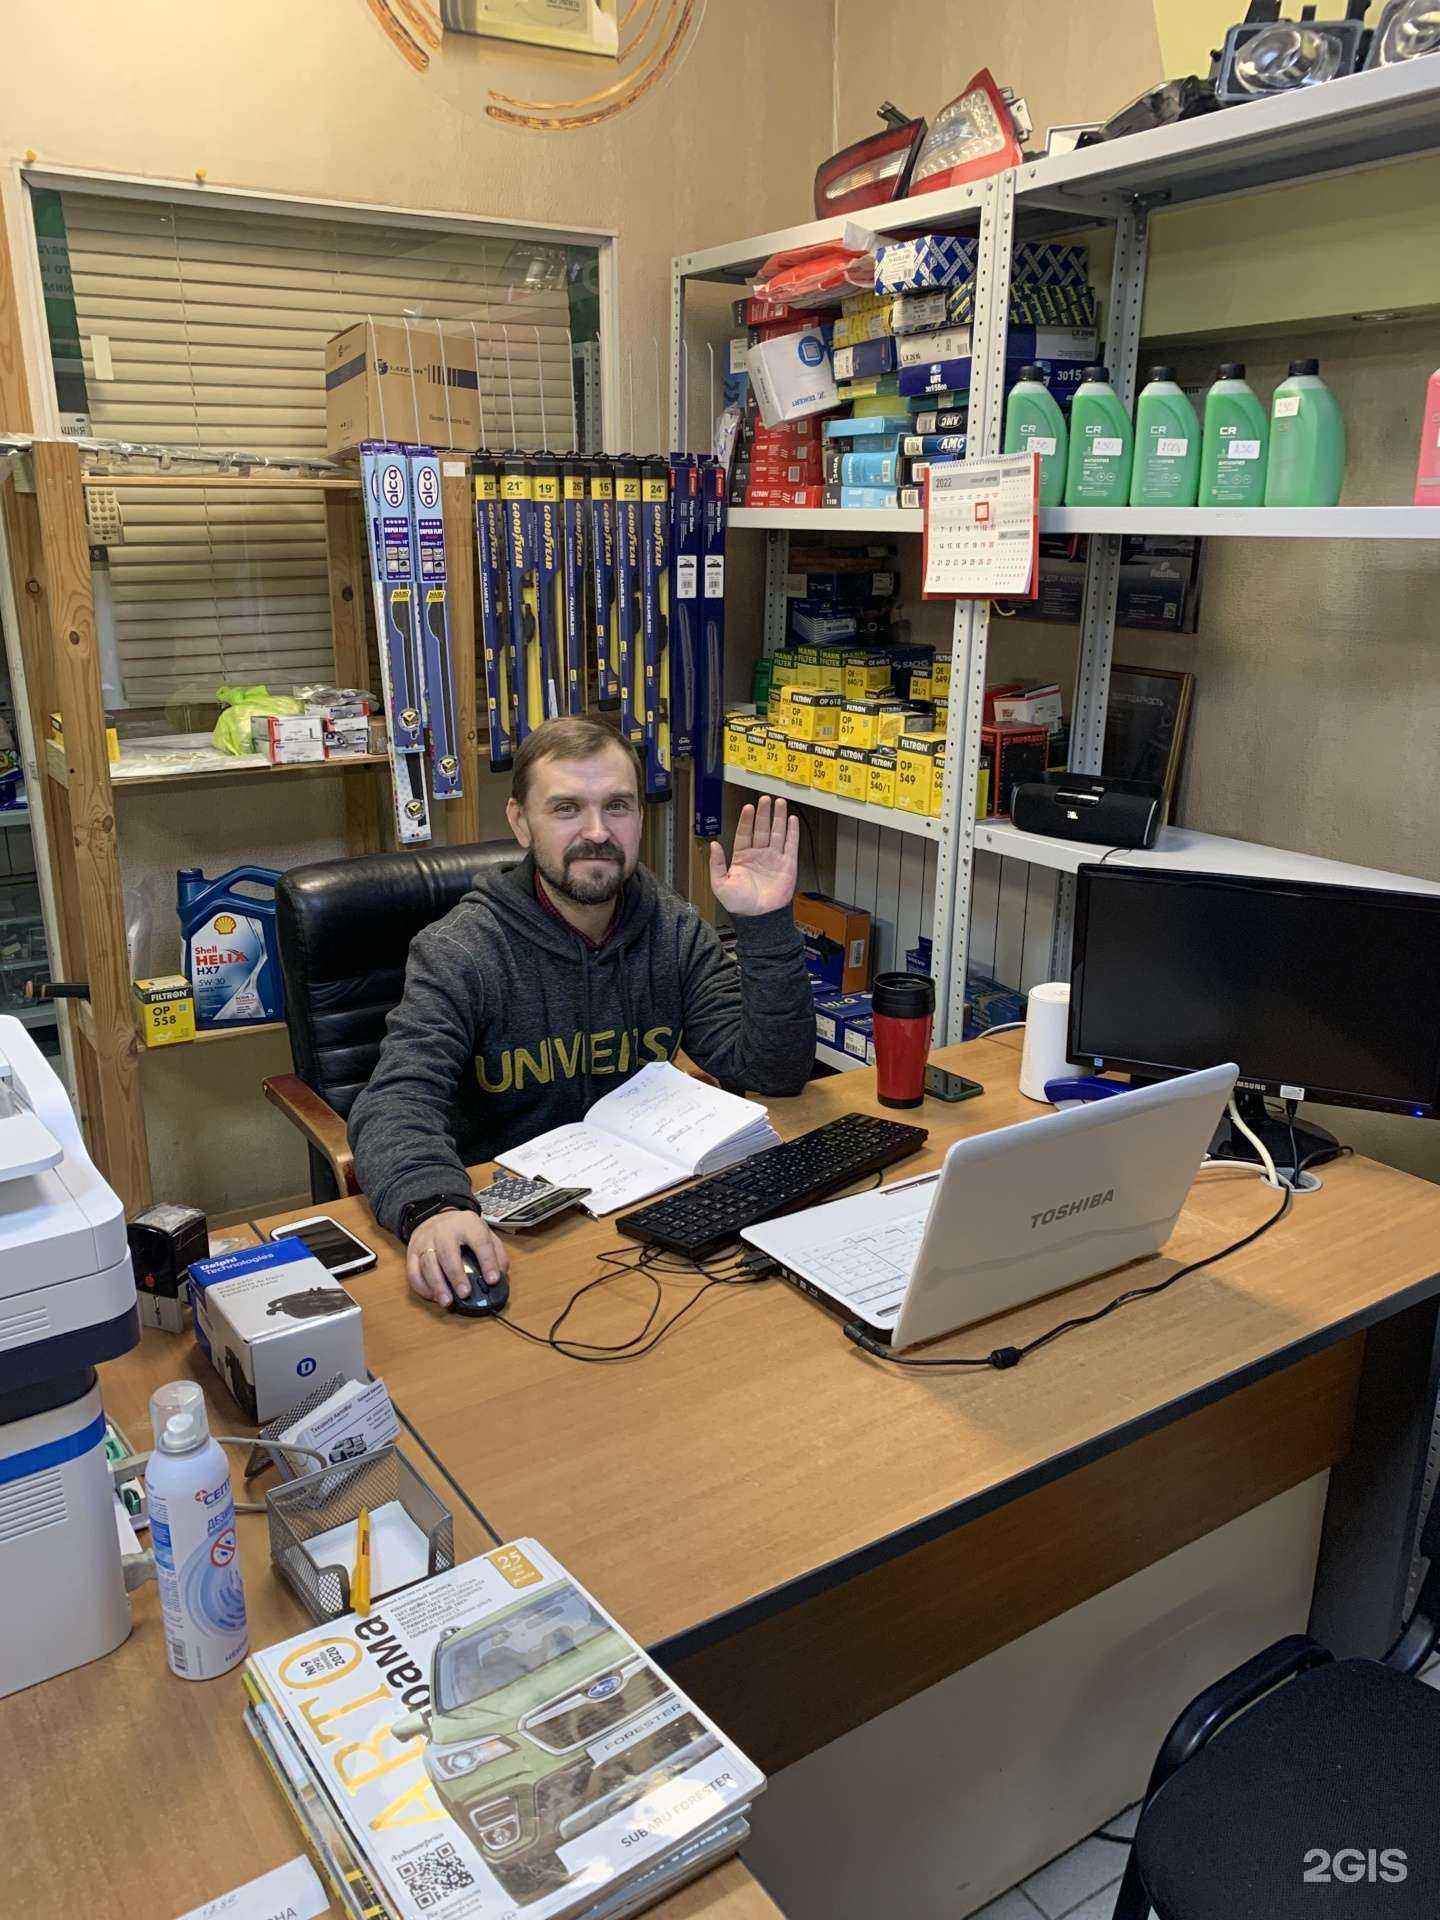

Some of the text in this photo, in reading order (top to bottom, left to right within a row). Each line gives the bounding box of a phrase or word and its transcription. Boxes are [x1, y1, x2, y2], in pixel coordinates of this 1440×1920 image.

[1057, 369, 1082, 381] 3015
[1020, 424, 1037, 433] CR
[1085, 425, 1102, 434] CR
[1150, 426, 1167, 434] CR
[1219, 426, 1237, 435] CR
[941, 437, 964, 450] AMC
[387, 469, 399, 504] alca
[422, 471, 433, 505] alca
[936, 477, 952, 488] 2022
[488, 502, 498, 569] GOODYEAR
[512, 502, 524, 569] GOODYEAR
[543, 504, 555, 569] GOODYEAR
[575, 502, 585, 567] GOODYEAR
[603, 503, 612, 566] GOODYEAR
[628, 504, 638, 567] GOODYEAR
[654, 504, 664, 567] GOODYEAR
[792, 695, 812, 704] FILTRON
[792, 707, 801, 715] OP
[846, 704, 867, 713] FILTRON
[791, 717, 803, 727] 618
[841, 716, 852, 724] OP
[768, 731, 785, 740] FILTRON
[840, 726, 855, 735] 617
[747, 735, 764, 745] FILTRON
[901, 740, 929, 752] FILTRON
[788, 742, 808, 751] FILTRON
[815, 746, 835, 758] FILTRON
[767, 753, 778, 762] 575
[840, 750, 864, 760] FILTRON
[787, 764, 798, 772] 557
[871, 758, 893, 768] FILTRON
[900, 761, 912, 770] OP
[900, 773, 916, 784] 549
[870, 780, 890, 793] 540/1
[194, 945, 217, 955] Shell
[195, 952, 248, 966] HELIX
[197, 966, 220, 976] HX7
[151, 989, 189, 1002] FILTRON
[152, 1007, 170, 1016] OP
[153, 1015, 177, 1027] 558
[1031, 1188, 1115, 1229] TOSHIBA
[199, 1256, 237, 1272] Delphi
[206, 1252, 274, 1276] Technologies
[325, 1646, 346, 1665] 2020
[355, 1614, 431, 1717] рама
[603, 1702, 684, 1751] FORESTER
[278, 1636, 450, 1833] АВТО
[621, 1772, 734, 1849] SUBARU FORESTER
